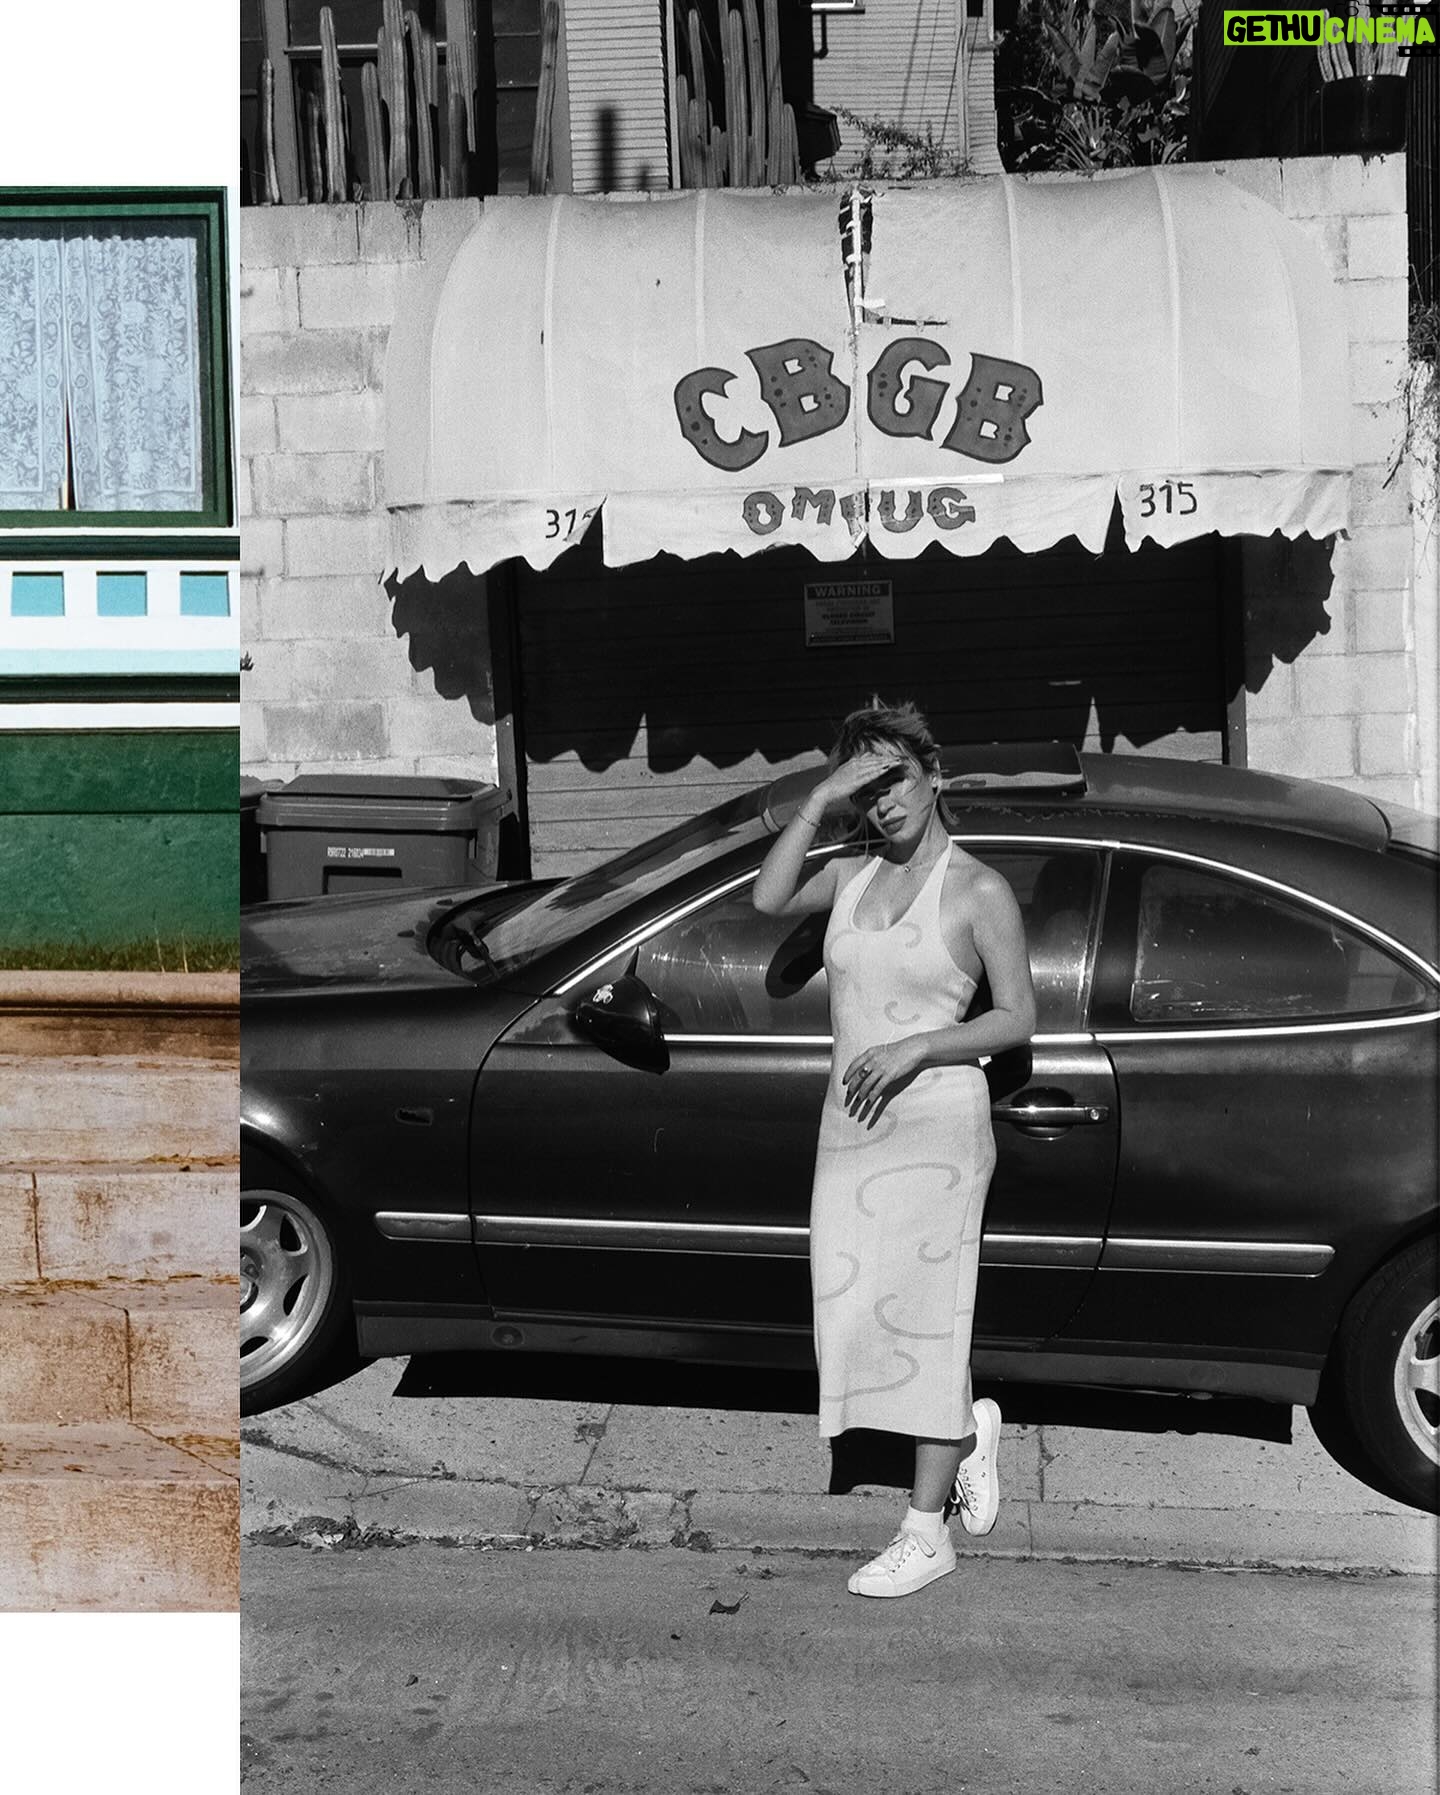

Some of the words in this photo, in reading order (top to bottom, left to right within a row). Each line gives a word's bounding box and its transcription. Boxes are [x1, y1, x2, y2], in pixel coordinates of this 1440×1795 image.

[673, 337, 1045, 473] CBGB
[1139, 480, 1198, 518] 315
[815, 584, 881, 598] WARNING
